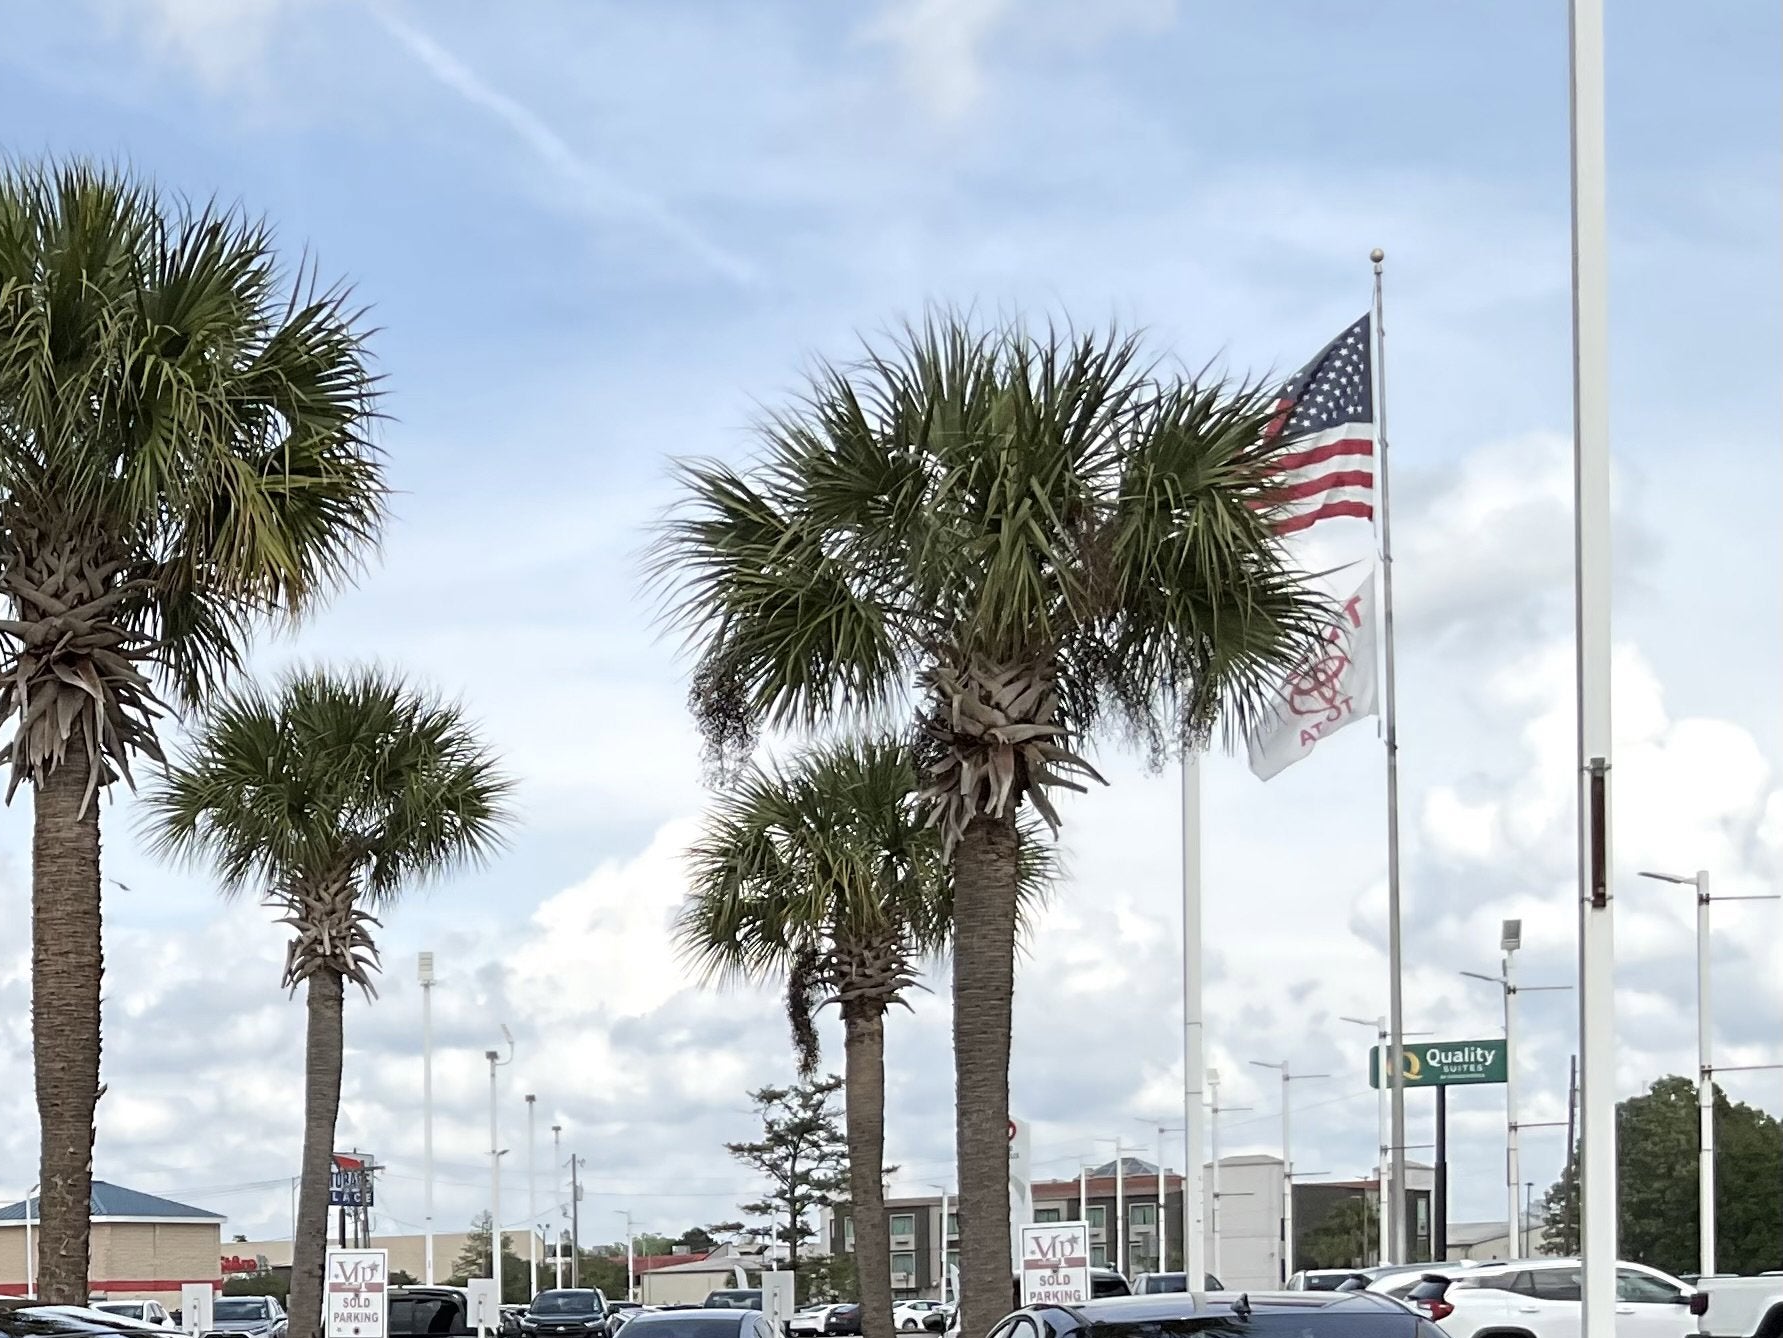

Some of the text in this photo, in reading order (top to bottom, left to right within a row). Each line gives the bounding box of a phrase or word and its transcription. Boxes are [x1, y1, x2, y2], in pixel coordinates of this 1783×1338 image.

[1426, 1046, 1496, 1067] Quality
[1443, 1063, 1484, 1073] SUITES
[332, 1191, 372, 1203] LACE
[1039, 1274, 1071, 1287] SOLD
[1029, 1289, 1082, 1303] PARKING
[343, 1297, 371, 1309] SOLD
[333, 1311, 379, 1323] PARKING
